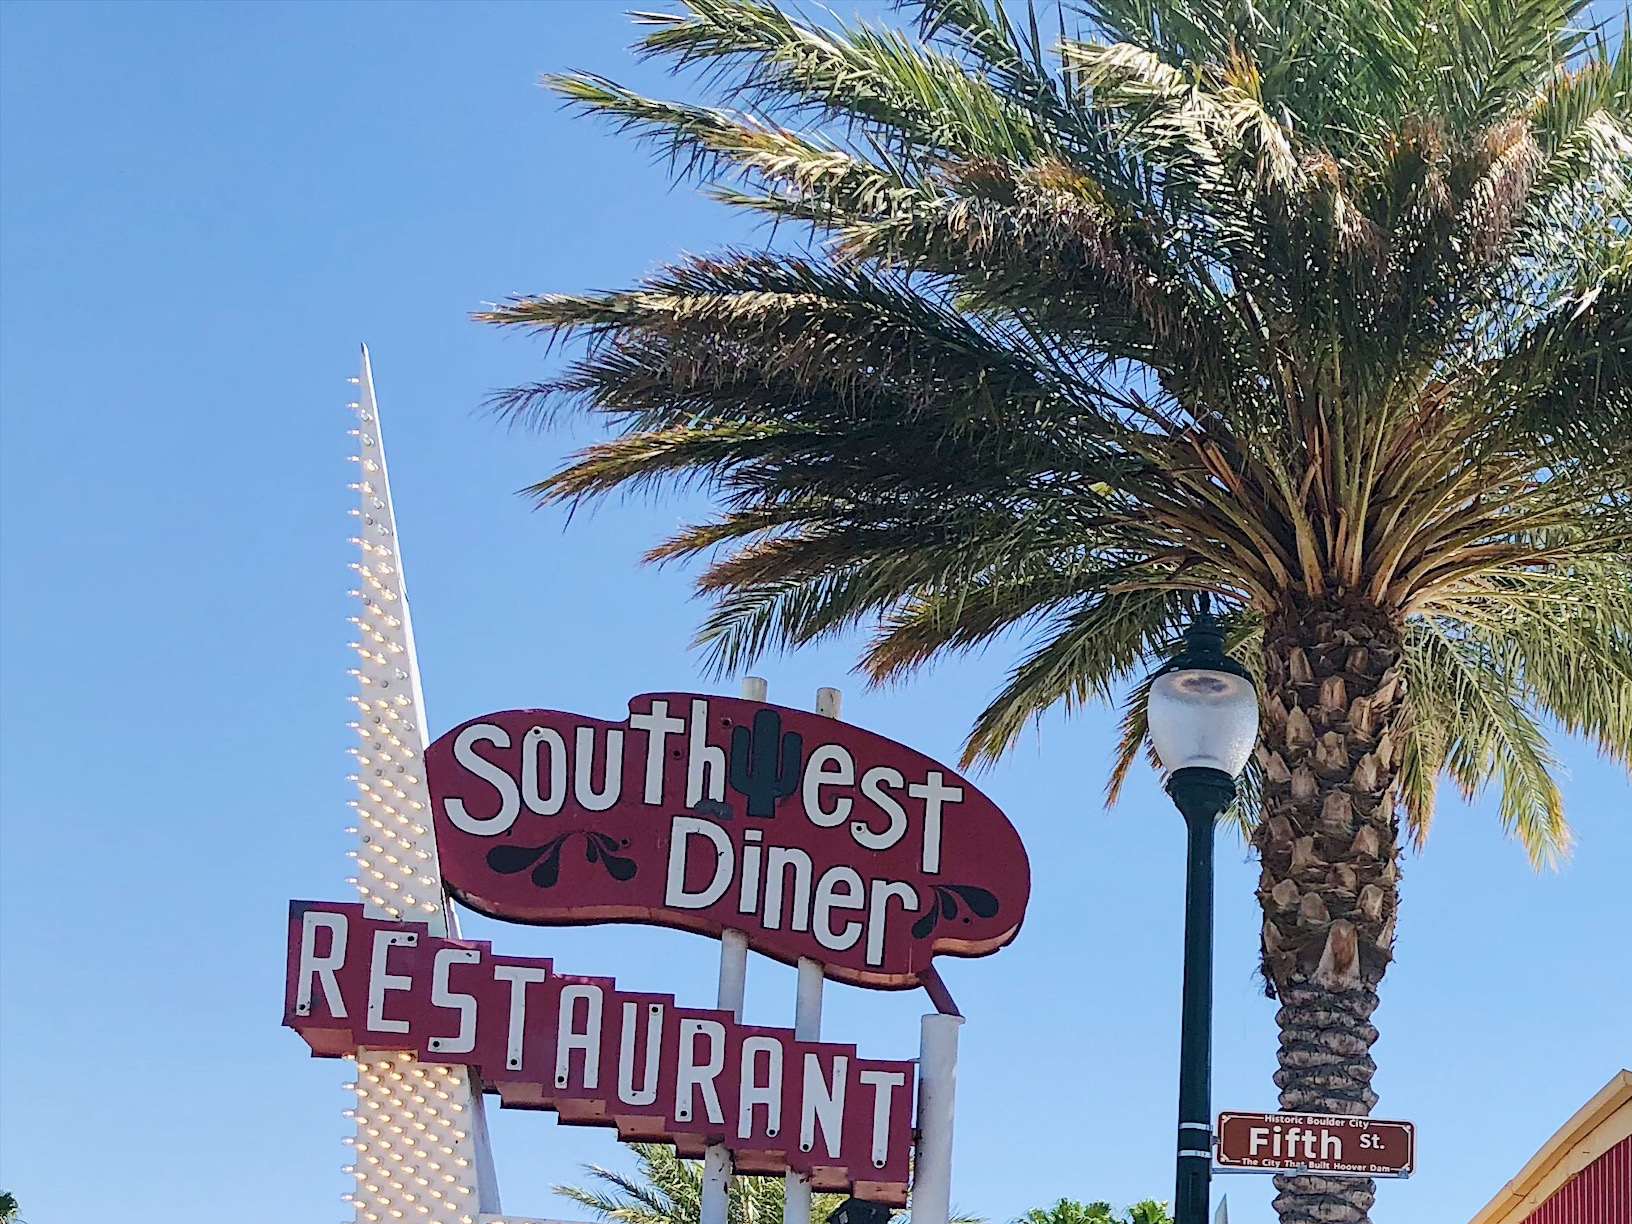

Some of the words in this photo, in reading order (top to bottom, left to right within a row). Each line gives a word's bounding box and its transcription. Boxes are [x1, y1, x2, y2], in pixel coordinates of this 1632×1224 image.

[664, 816, 919, 968] Diner
[295, 911, 906, 1169] RESTAURANT
[1264, 1115, 1303, 1125] Historic
[1307, 1117, 1345, 1127] Boulder
[1349, 1119, 1370, 1130] City
[1249, 1126, 1342, 1160] Fifth
[1359, 1134, 1385, 1150] St.
[1242, 1158, 1258, 1166] The
[1262, 1159, 1281, 1168] City
[1309, 1161, 1330, 1170] Built
[1333, 1162, 1368, 1172] Hoover
[1369, 1164, 1391, 1173] Dam
